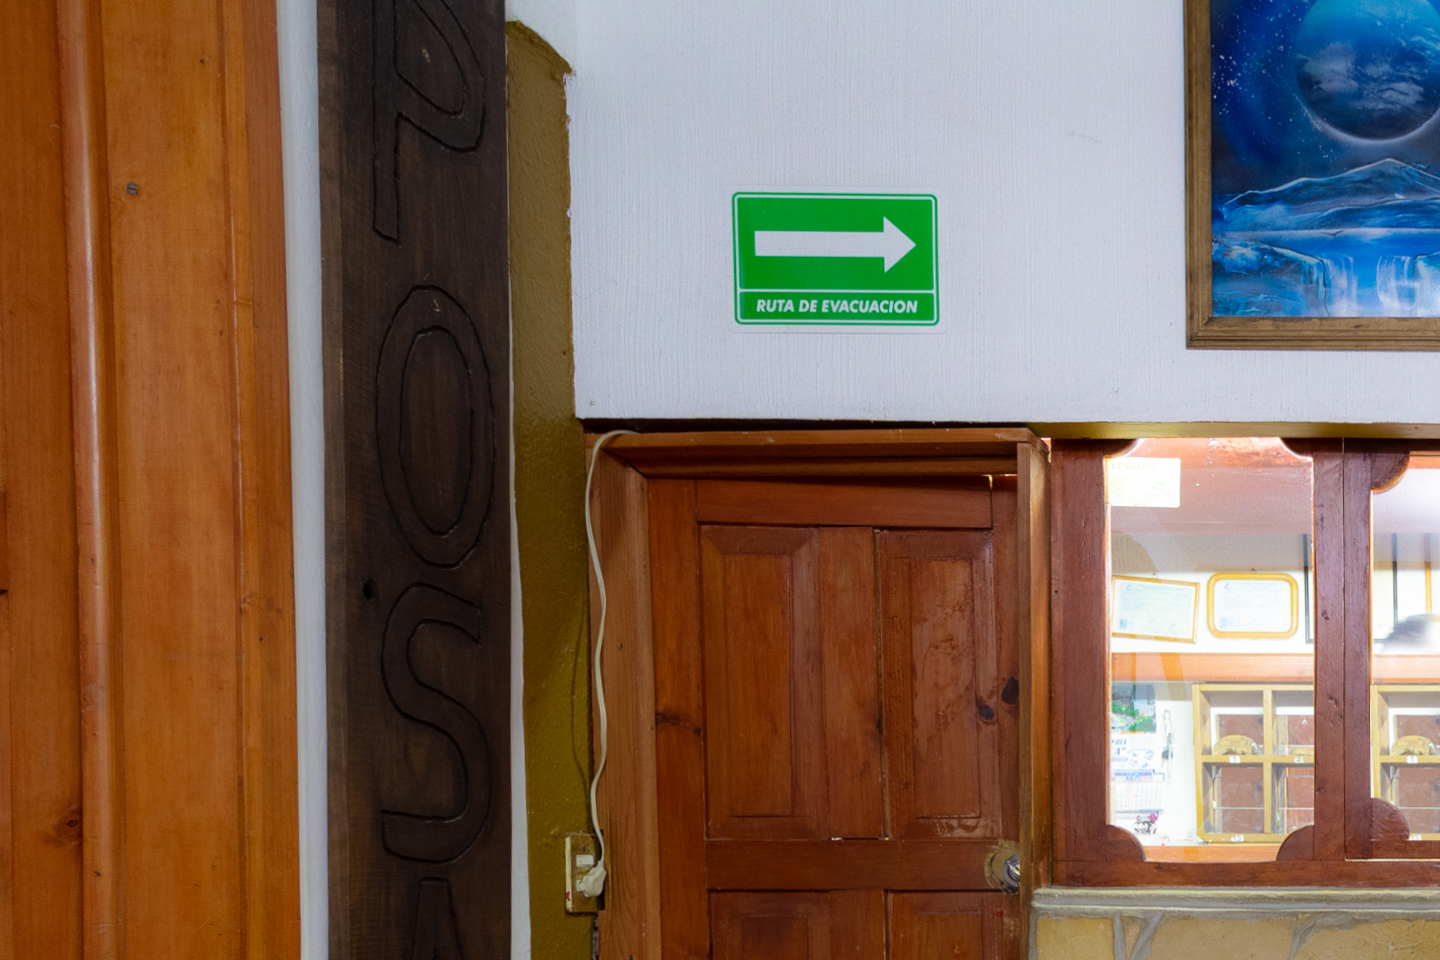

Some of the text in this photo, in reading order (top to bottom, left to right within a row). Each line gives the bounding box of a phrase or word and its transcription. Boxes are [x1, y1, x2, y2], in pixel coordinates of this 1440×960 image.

[756, 299, 919, 314] RUTA DE EVACUACION
[1111, 463, 1156, 471] CENSADO
